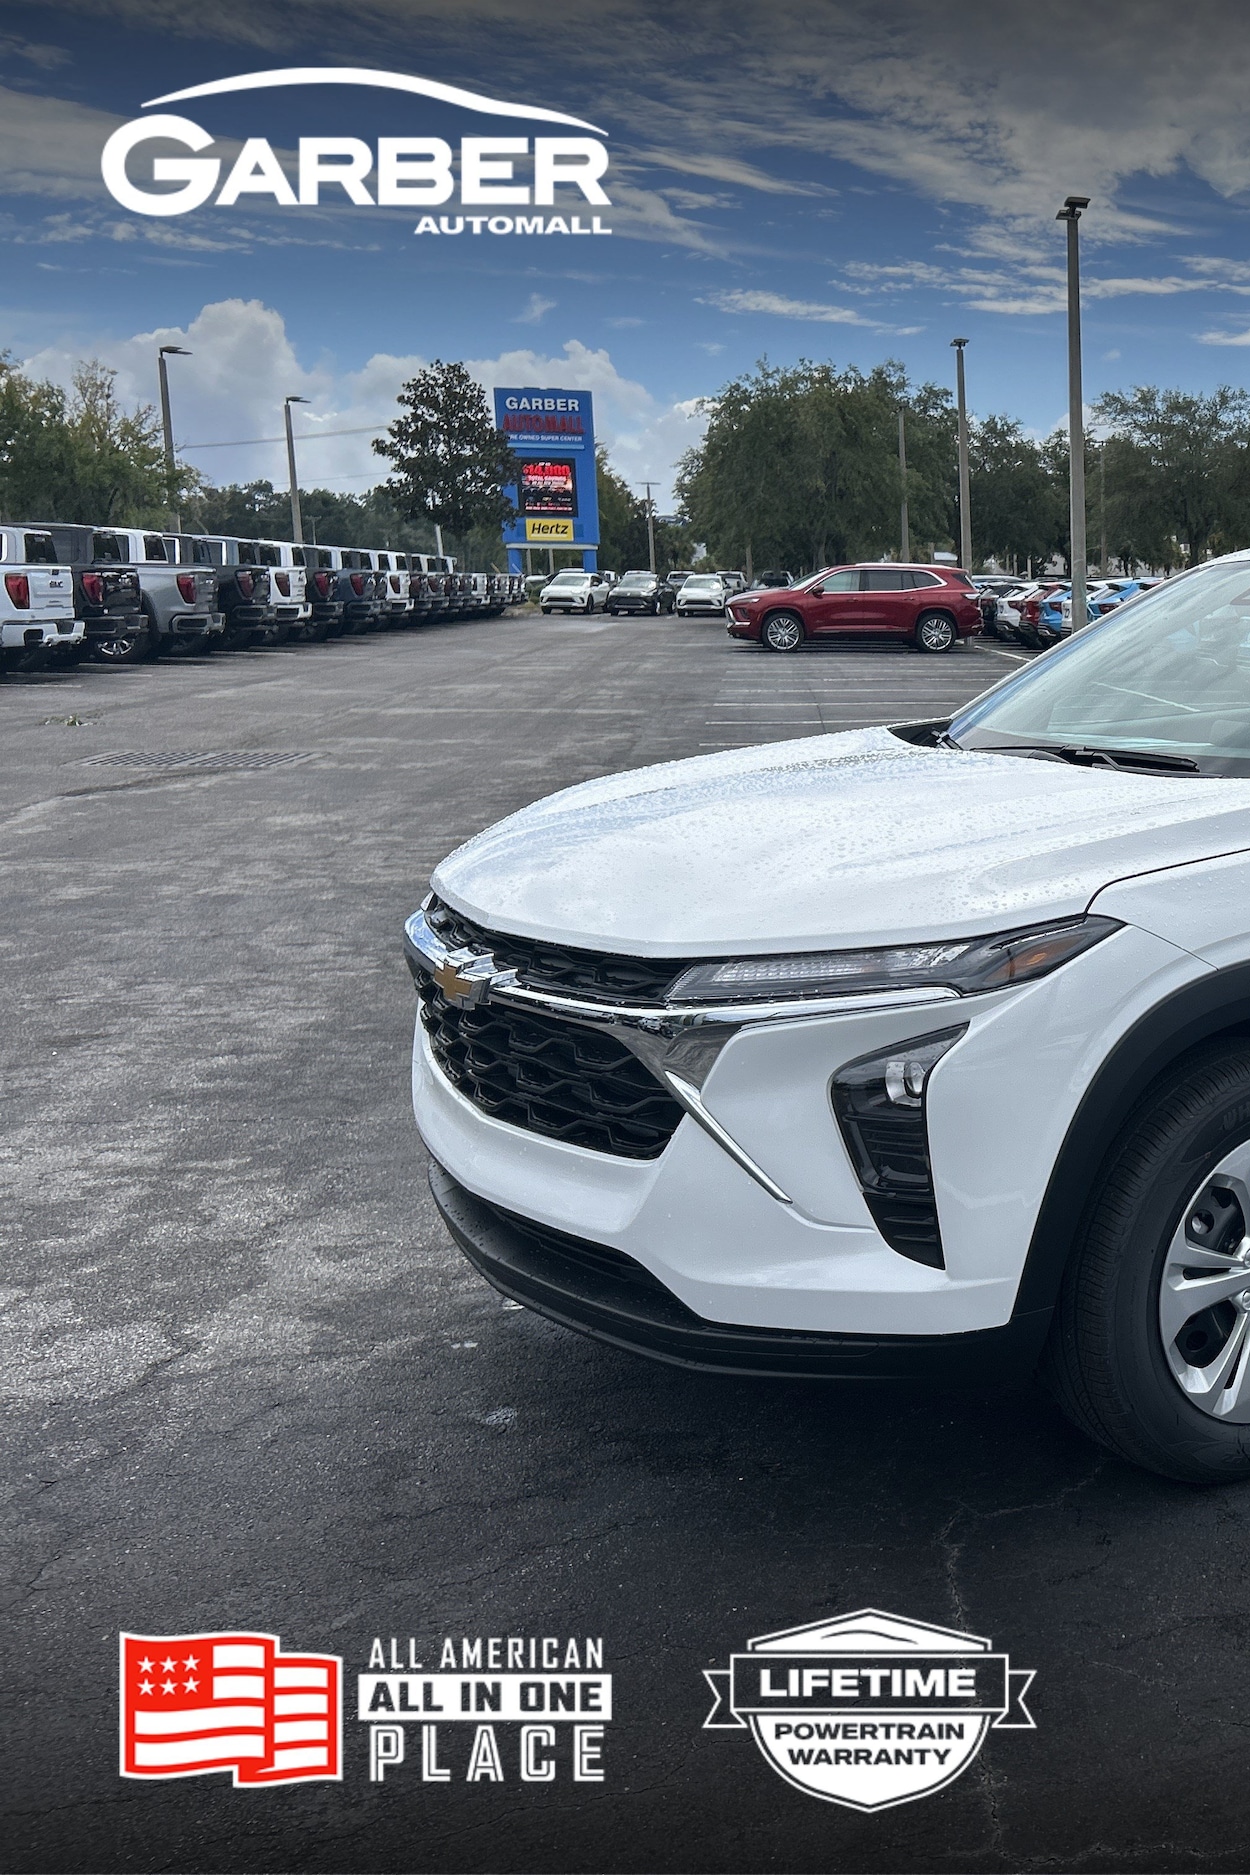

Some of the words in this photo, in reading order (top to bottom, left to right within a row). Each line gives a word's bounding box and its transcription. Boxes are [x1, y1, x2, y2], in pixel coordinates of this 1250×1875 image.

[505, 396, 579, 412] GARBER
[502, 413, 584, 434] AUTOMALL
[531, 522, 569, 535] Hertz
